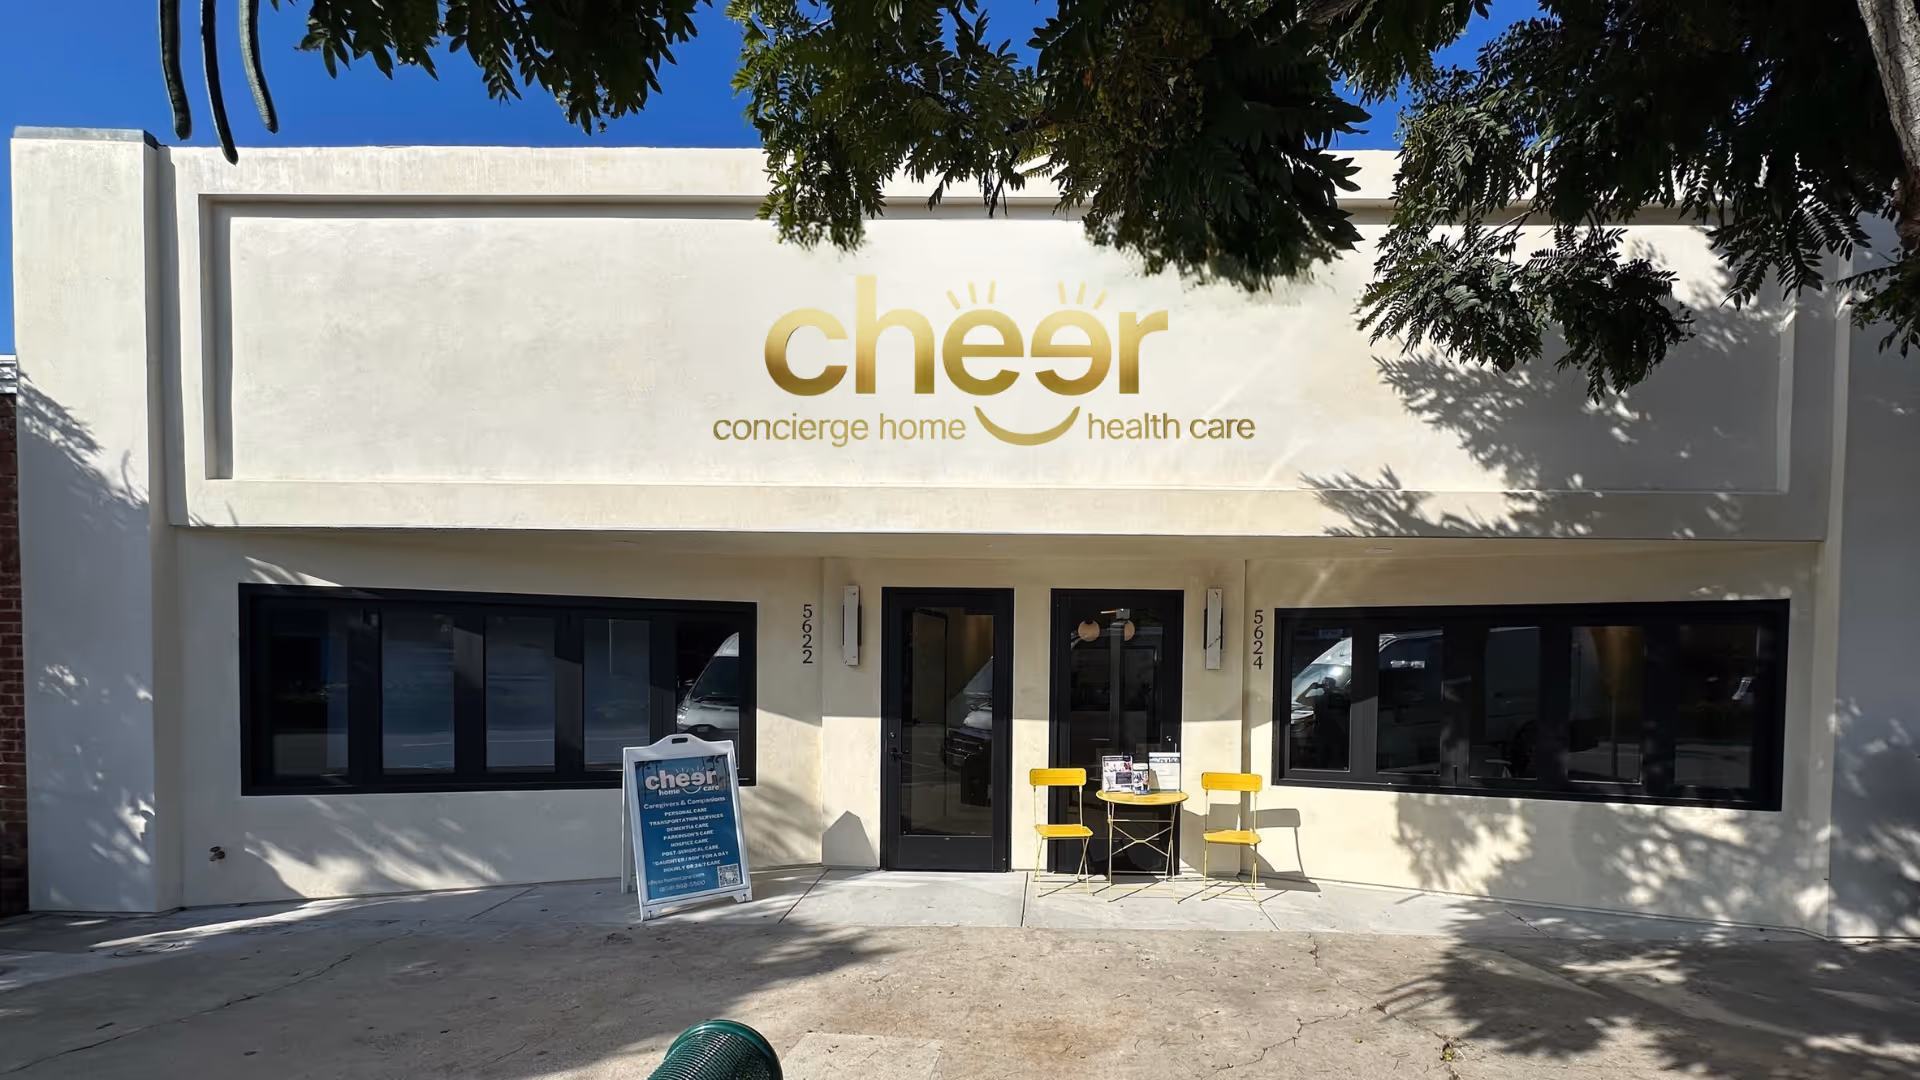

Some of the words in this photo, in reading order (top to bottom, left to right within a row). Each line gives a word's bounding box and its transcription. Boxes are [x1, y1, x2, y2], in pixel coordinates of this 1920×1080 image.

[765, 275, 1168, 396] cheer
[713, 413, 868, 446] concierge
[879, 413, 966, 440] home
[1088, 413, 1180, 440] health
[1189, 418, 1256, 440] care
[802, 603, 813, 664] 5622
[1253, 609, 1263, 670] 5624
[645, 769, 716, 790] cheer
[643, 800, 680, 810] Caregivers
[687, 796, 726, 805] Companions
[649, 816, 699, 827] TRANSPORTATION
[699, 813, 724, 821] SERVICES
[664, 809, 693, 817] PERSONAL
[663, 832, 699, 841] PARKINSON'S
[663, 865, 686, 873] HOURLY
